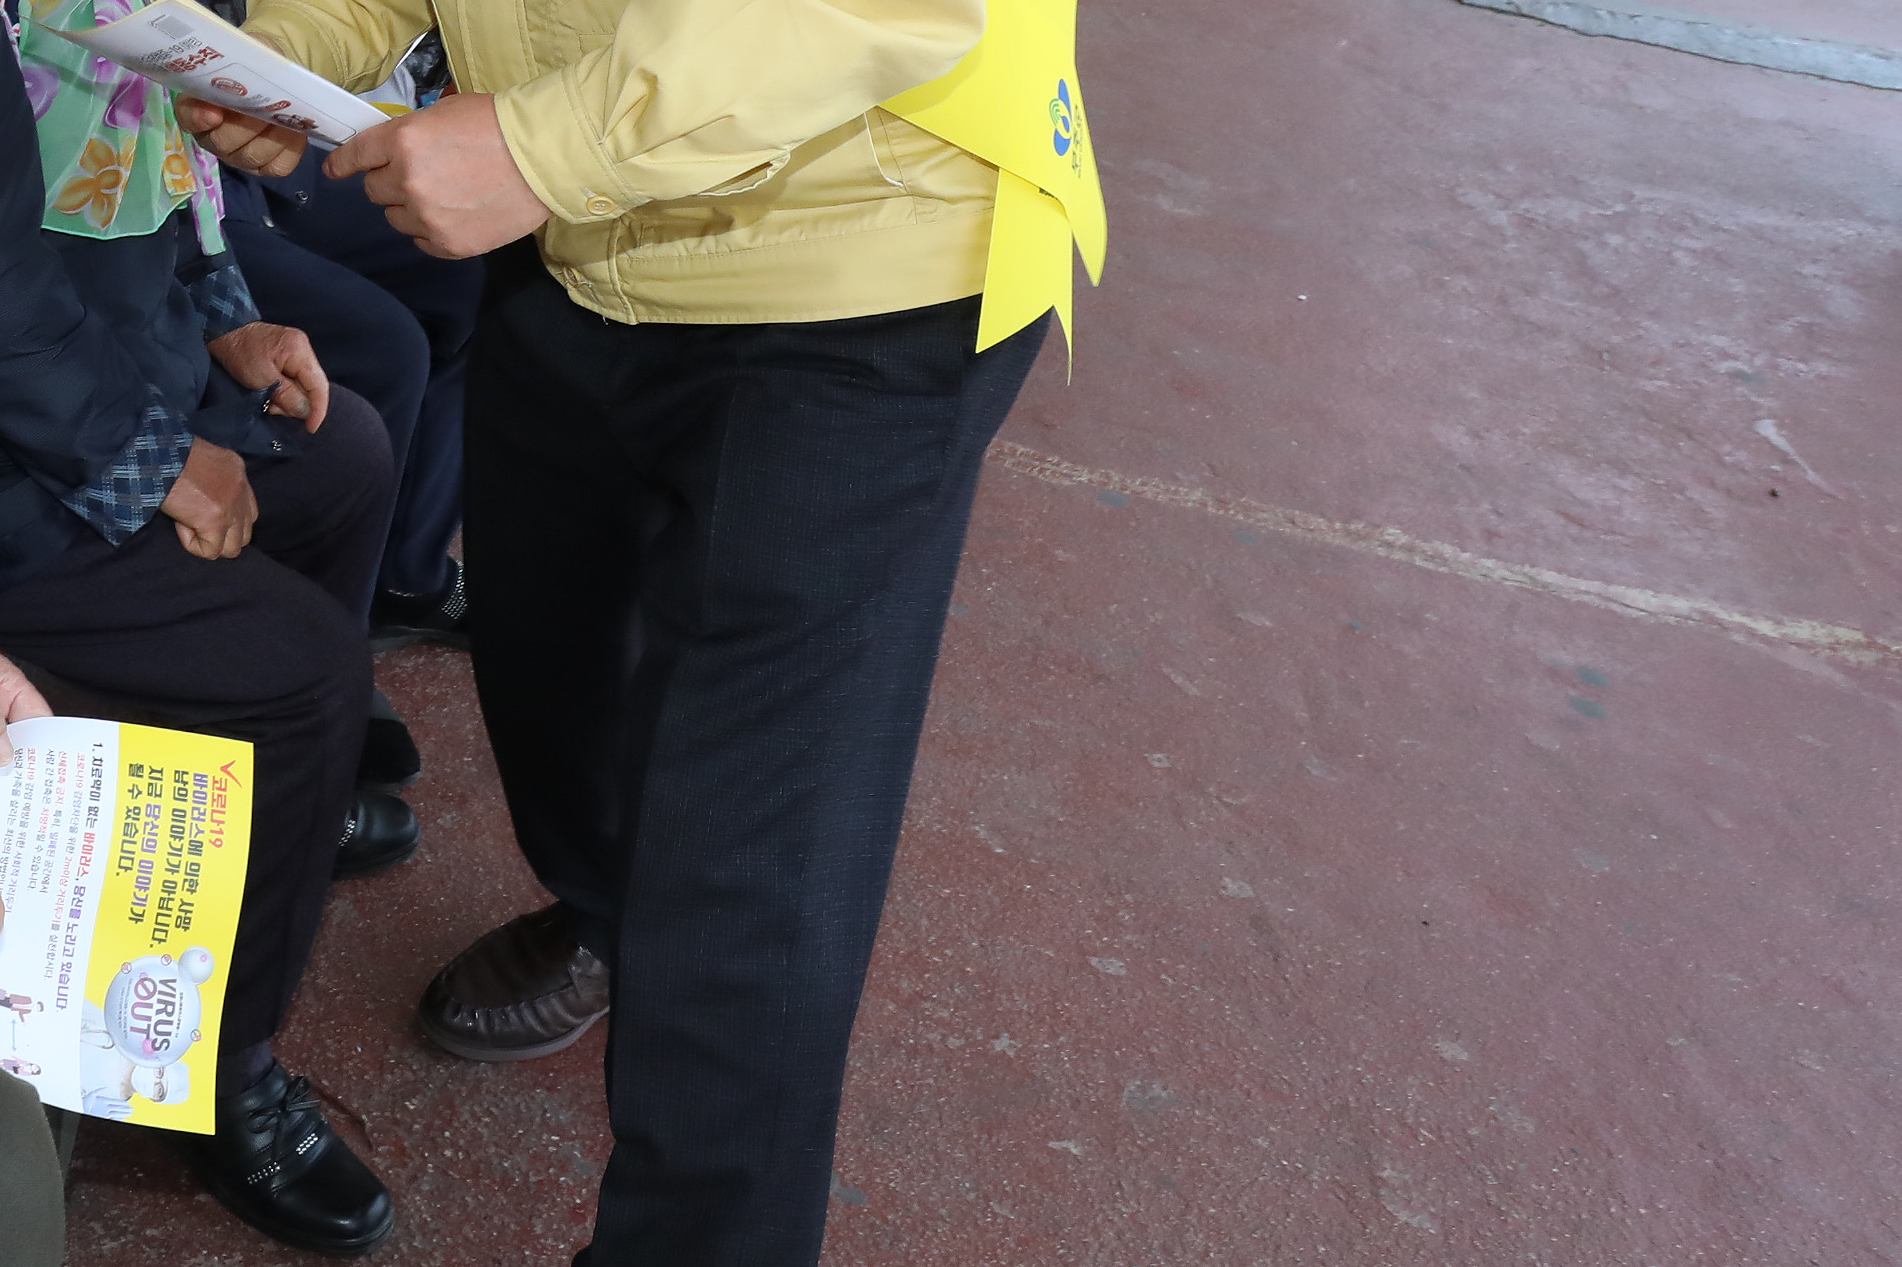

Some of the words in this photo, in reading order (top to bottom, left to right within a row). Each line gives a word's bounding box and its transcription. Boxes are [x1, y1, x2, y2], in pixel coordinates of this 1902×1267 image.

[26, 747, 36, 781] 코로나19
[45, 749, 56, 765] 사람
[91, 742, 104, 752] 1.
[11, 771, 23, 797] 가족을
[45, 767, 54, 776] 간
[57, 751, 68, 784] 신체접촉
[75, 753, 85, 789] 코로나19
[88, 756, 104, 802] 치료약이
[147, 765, 165, 799] 지금
[42, 778, 54, 805] 접촉은
[127, 783, 143, 800] 수
[173, 769, 189, 803] 남의
[6, 799, 19, 826] 살리는
[19, 802, 32, 829] 예방을
[35, 807, 50, 842] 치명적일
[85, 805, 99, 829] 없는
[140, 803, 162, 854] 당신의
[187, 772, 209, 857] 바이러스에
[208, 775, 228, 849] 코로나19
[1, 828, 15, 854] 최선의
[15, 831, 28, 849] 위한
[34, 845, 44, 853] 수
[65, 836, 77, 854] 위한
[74, 832, 96, 882] 바이러스,
[116, 805, 142, 877] 있습니다.
[164, 807, 188, 876] 이야기가
[10, 852, 23, 877] 사회적
[27, 855, 43, 891] 있습니다.
[39, 860, 54, 893] 공간에서
[59, 856, 73, 887] 2m이상
[181, 861, 201, 894] 의한
[4, 877, 20, 914] 거리두기
[68, 885, 86, 920] 당신을
[128, 859, 155, 925] 이야기가
[50, 888, 68, 931] 거리두기를
[149, 879, 179, 949] 아닙니다.
[174, 898, 195, 933] 사망
[62, 922, 79, 958] 노리고
[43, 934, 58, 981] 실천합시다.
[129, 976, 158, 1040] OUT
[151, 978, 178, 1052] VIRUS
